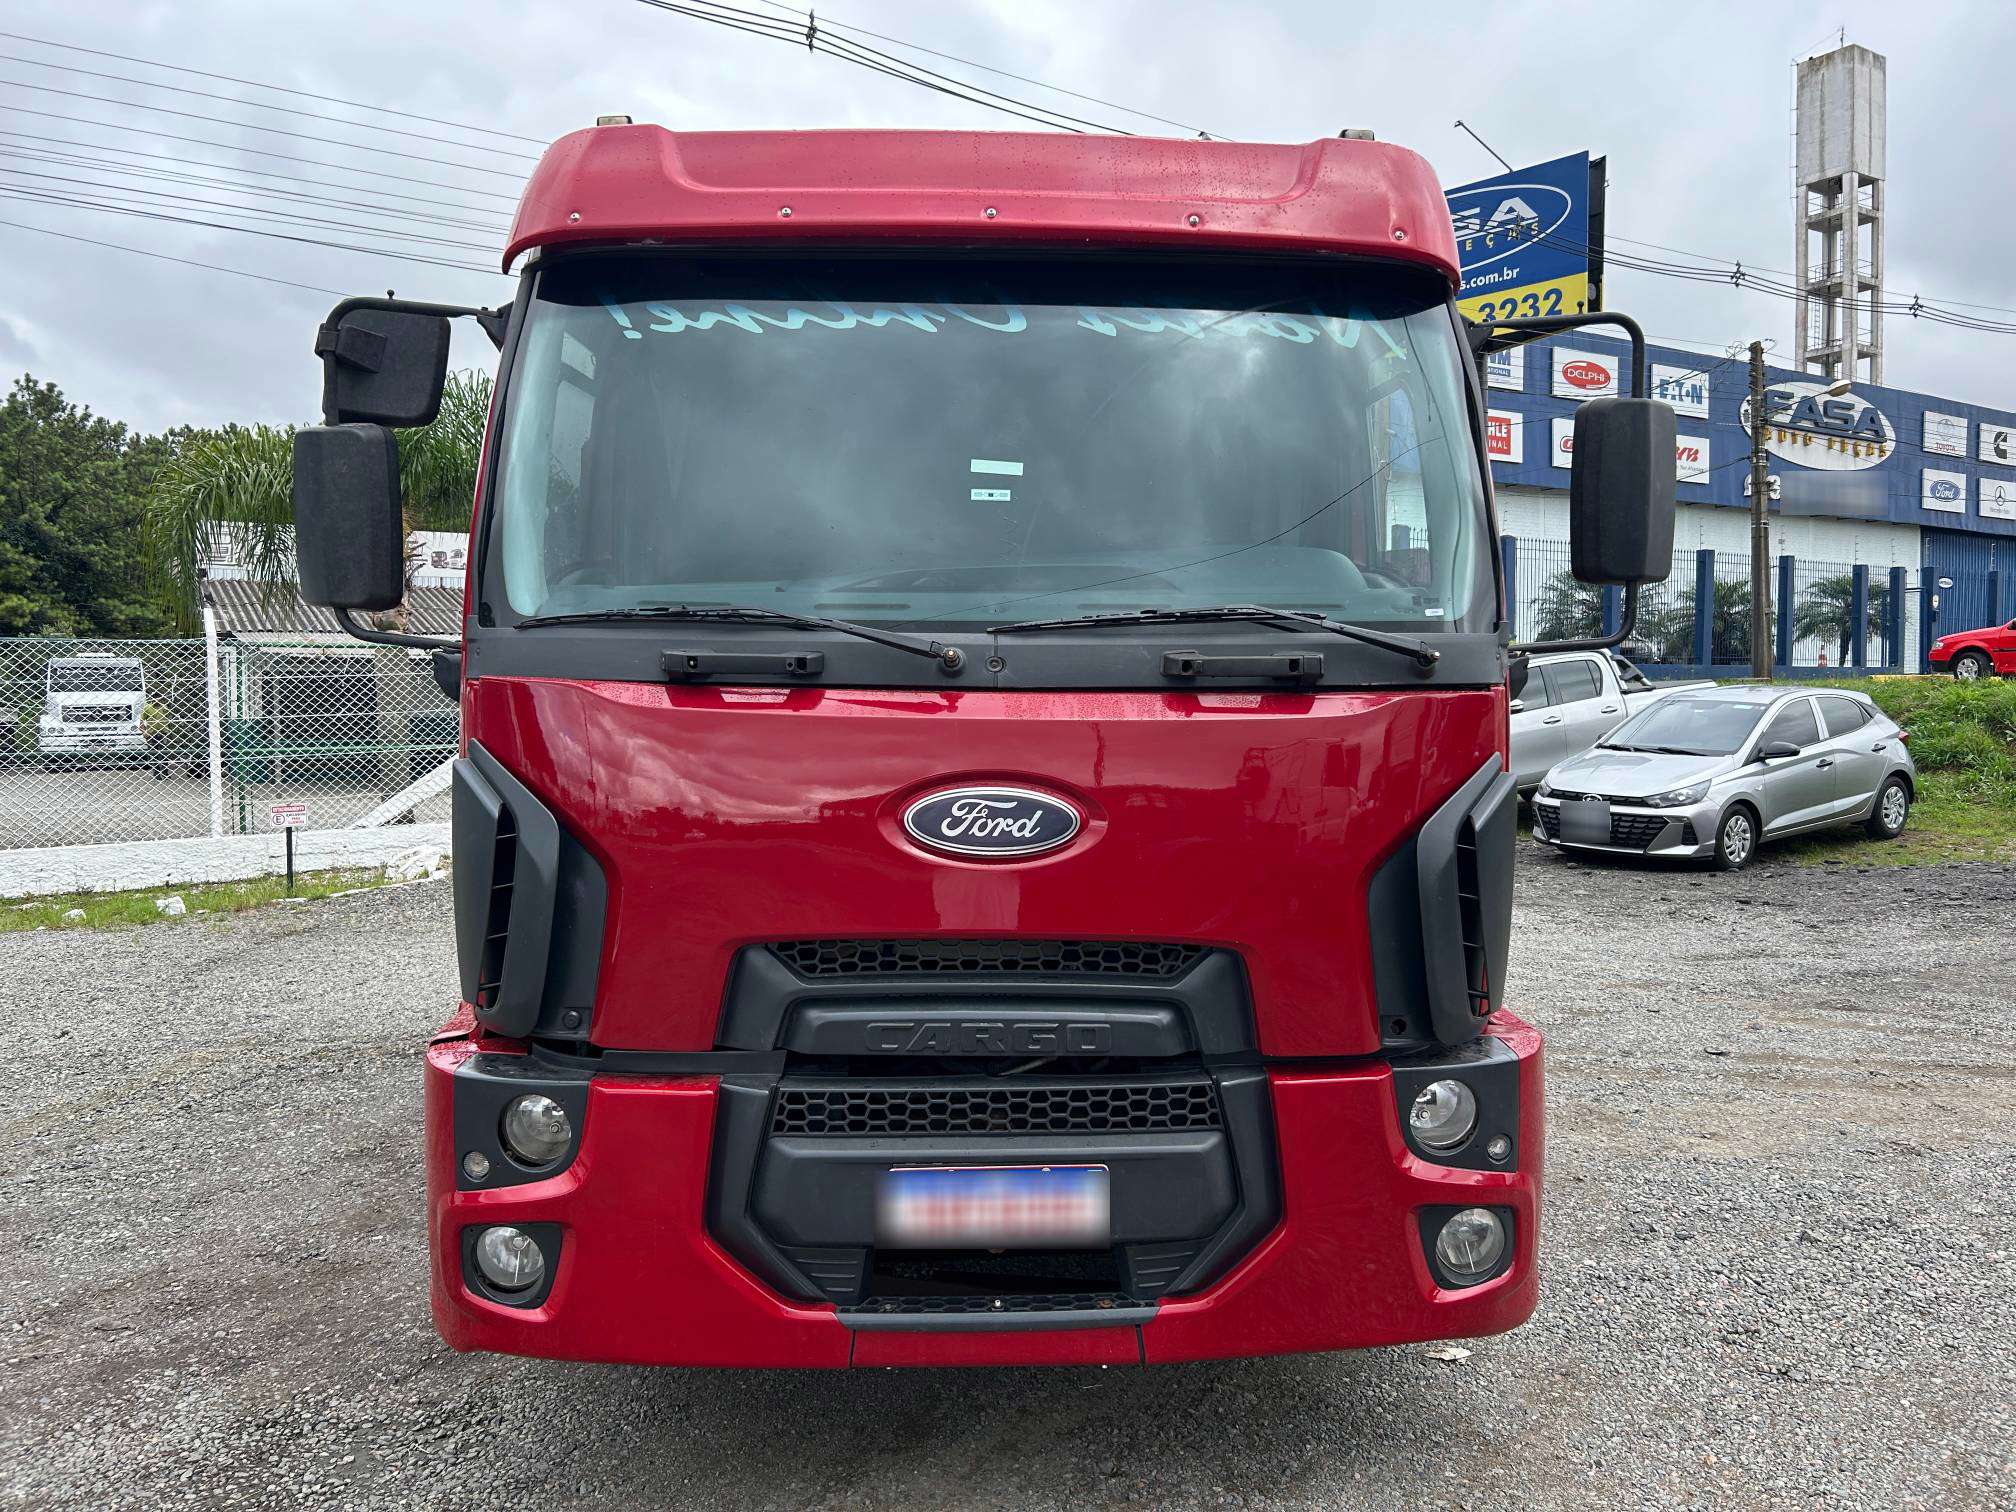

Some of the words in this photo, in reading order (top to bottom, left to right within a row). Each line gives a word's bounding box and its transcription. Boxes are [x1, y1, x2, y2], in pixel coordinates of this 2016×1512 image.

[1451, 197, 1539, 236] SA
[1465, 222, 1539, 251] EÇAS
[1459, 266, 1520, 291] s.com.br
[1567, 368, 1606, 382] DELPHI
[1488, 421, 1508, 437] HLE
[1488, 439, 1508, 450] INAL
[1935, 483, 1955, 499] Ford
[940, 798, 1043, 838] Ford
[865, 1021, 1113, 1053] CARGO
